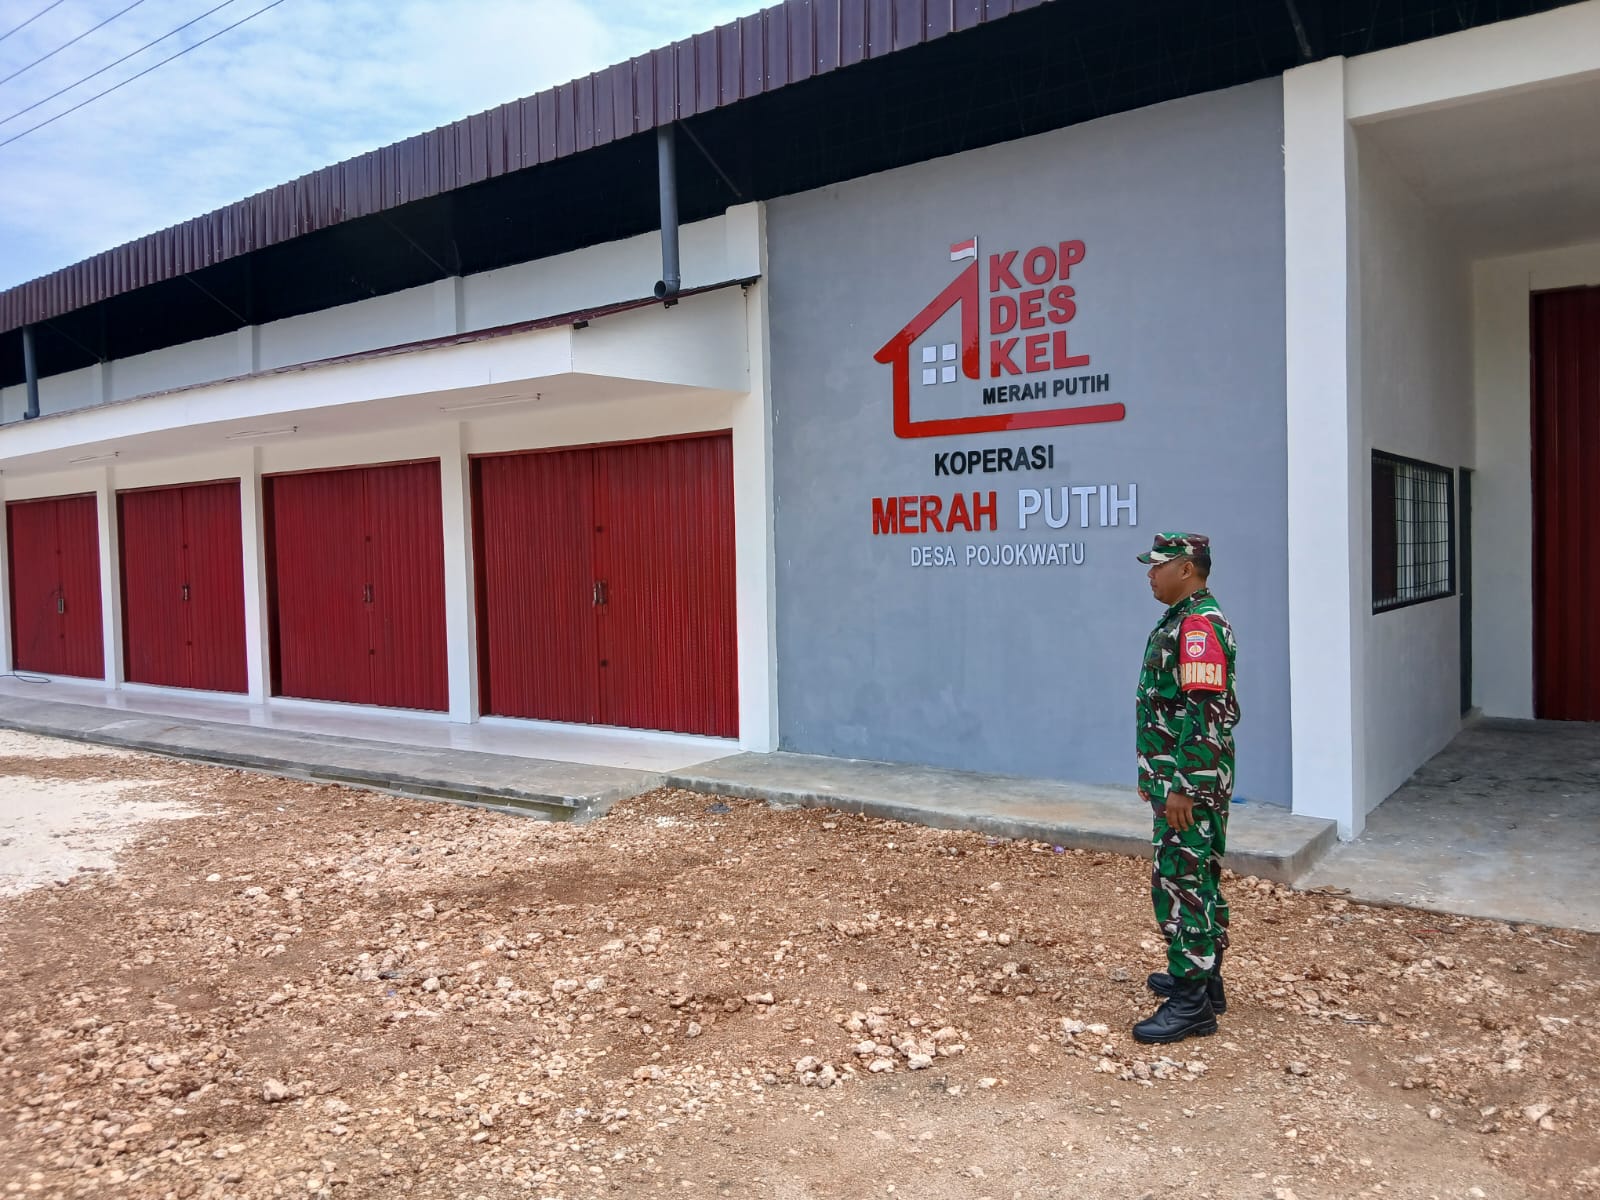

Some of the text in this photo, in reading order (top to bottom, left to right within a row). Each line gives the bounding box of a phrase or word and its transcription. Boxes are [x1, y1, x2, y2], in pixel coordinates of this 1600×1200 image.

[989, 239, 1086, 292] KOP
[990, 285, 1077, 335] DES
[990, 330, 1090, 378] KEL
[982, 373, 1109, 405] MERAH PUTIH
[934, 444, 1054, 476] KOPERASI
[872, 483, 1137, 535] MERAH PUTIH
[911, 542, 1085, 567] DESA POJOKWATU
